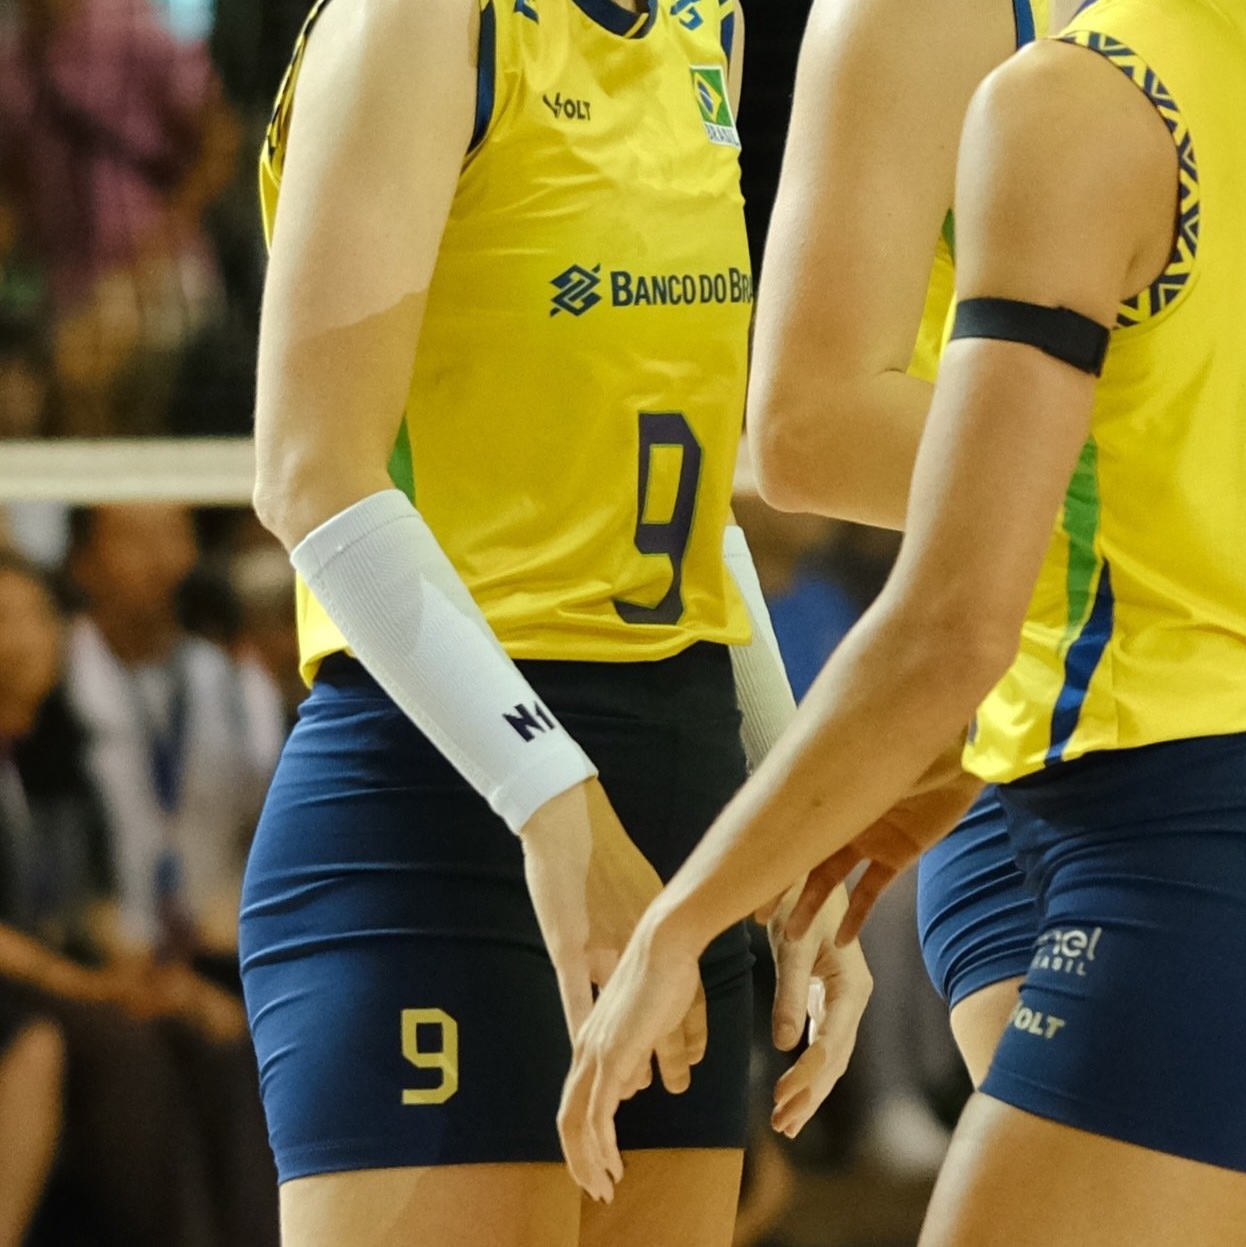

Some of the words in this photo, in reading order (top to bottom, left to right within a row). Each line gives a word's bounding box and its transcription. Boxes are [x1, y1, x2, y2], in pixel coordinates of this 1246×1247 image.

[542, 92, 591, 121] VOLT
[610, 270, 697, 307] BANCO
[699, 273, 727, 304] DO
[615, 411, 703, 626] 9
[401, 1007, 459, 1106] 9
